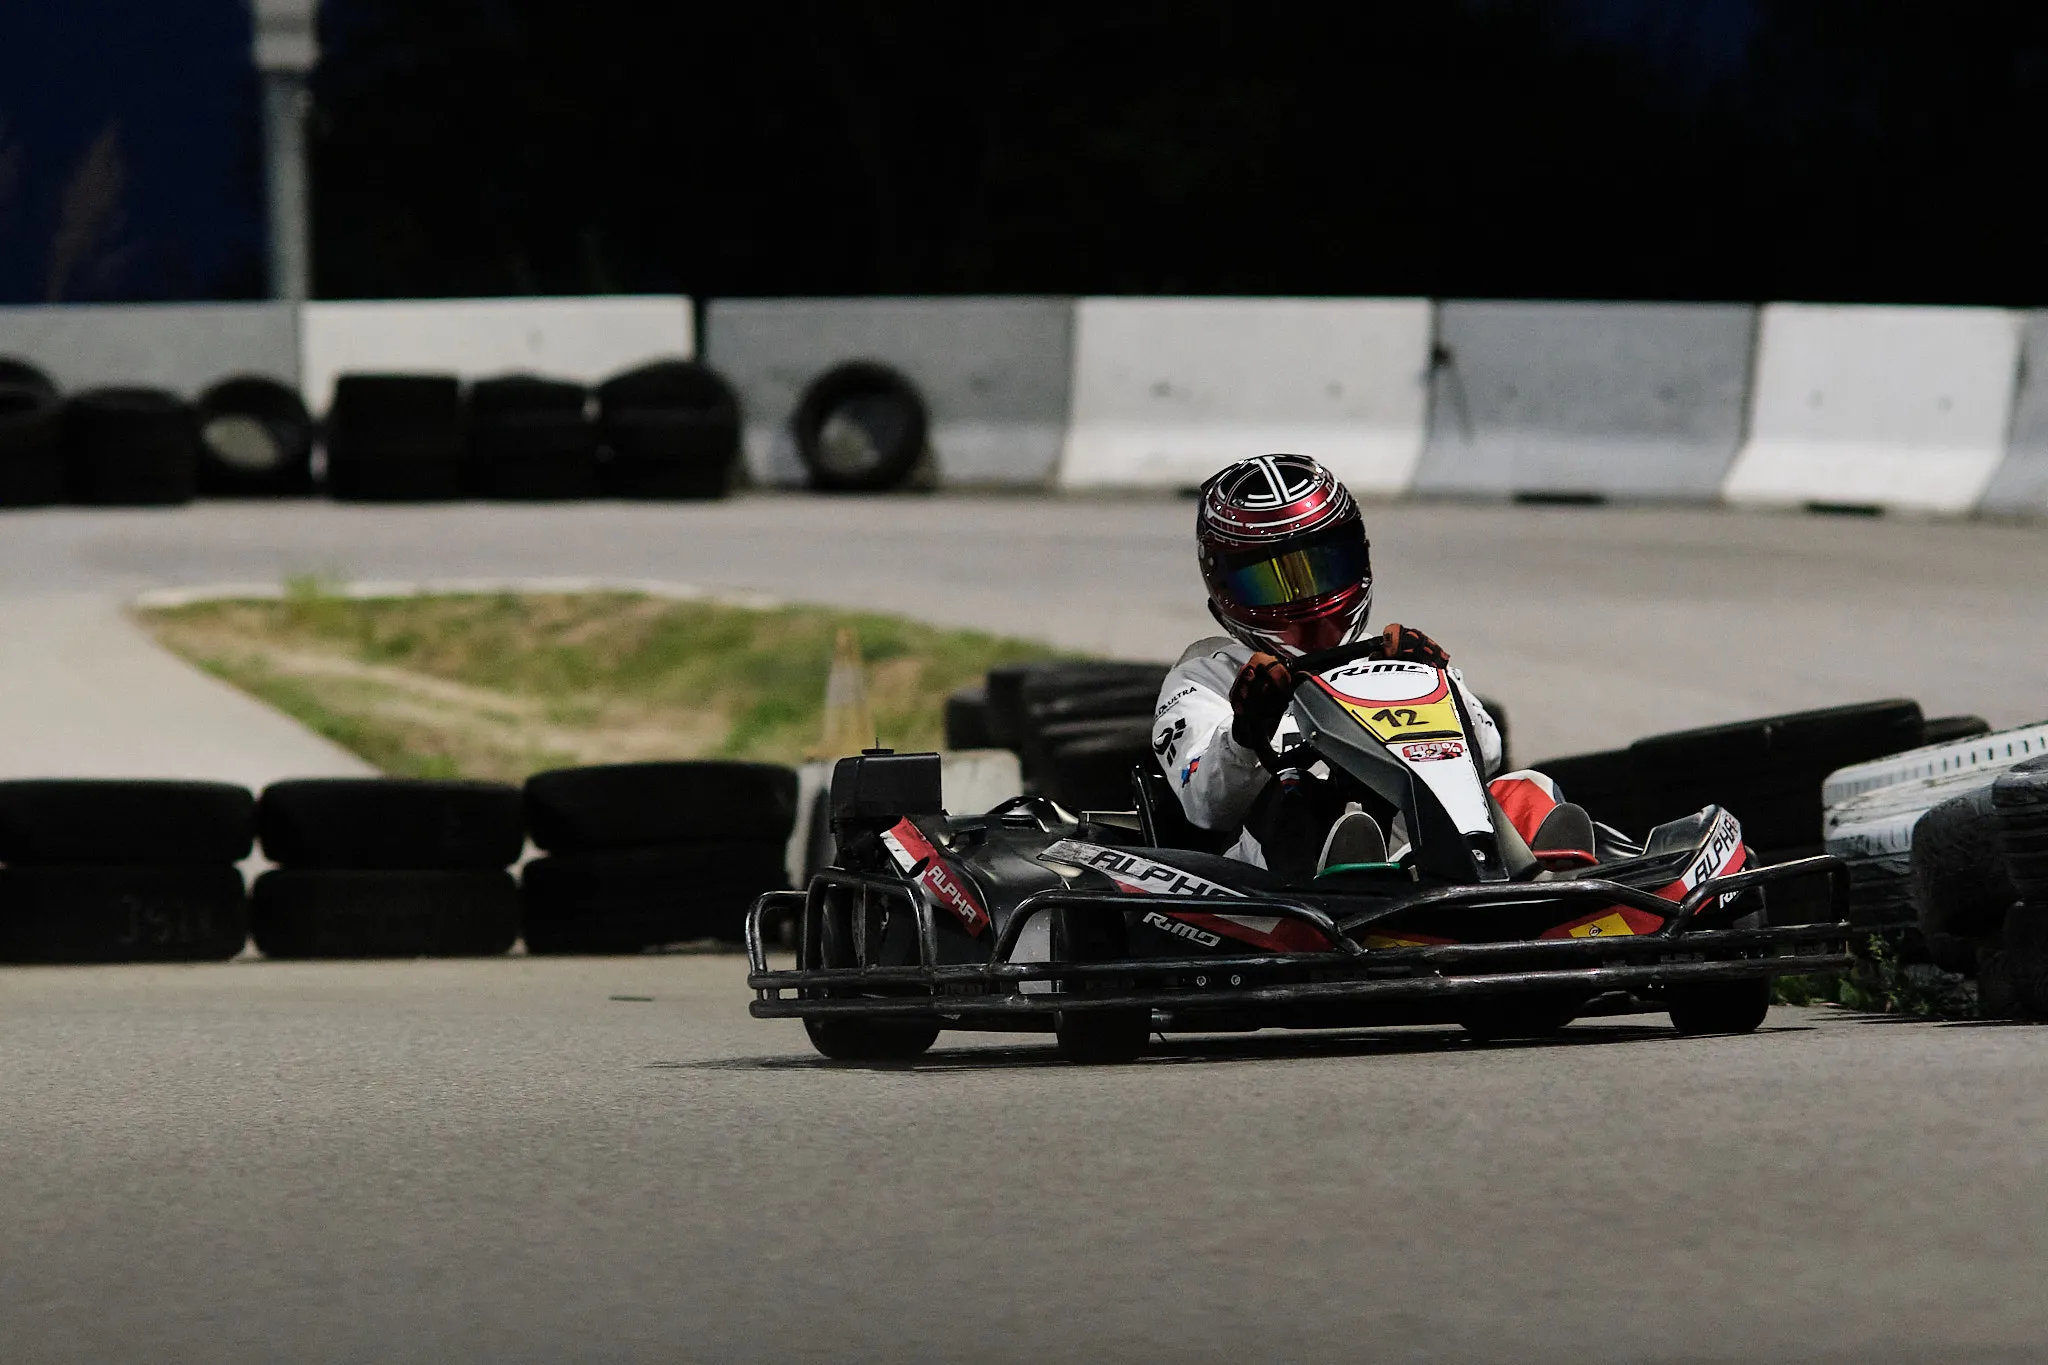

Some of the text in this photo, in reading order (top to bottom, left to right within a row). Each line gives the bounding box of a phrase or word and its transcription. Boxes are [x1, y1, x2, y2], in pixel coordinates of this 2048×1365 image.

[1372, 708, 1430, 728] 12
[1695, 819, 1738, 885] ALPHA
[927, 864, 977, 924] ALPHA
